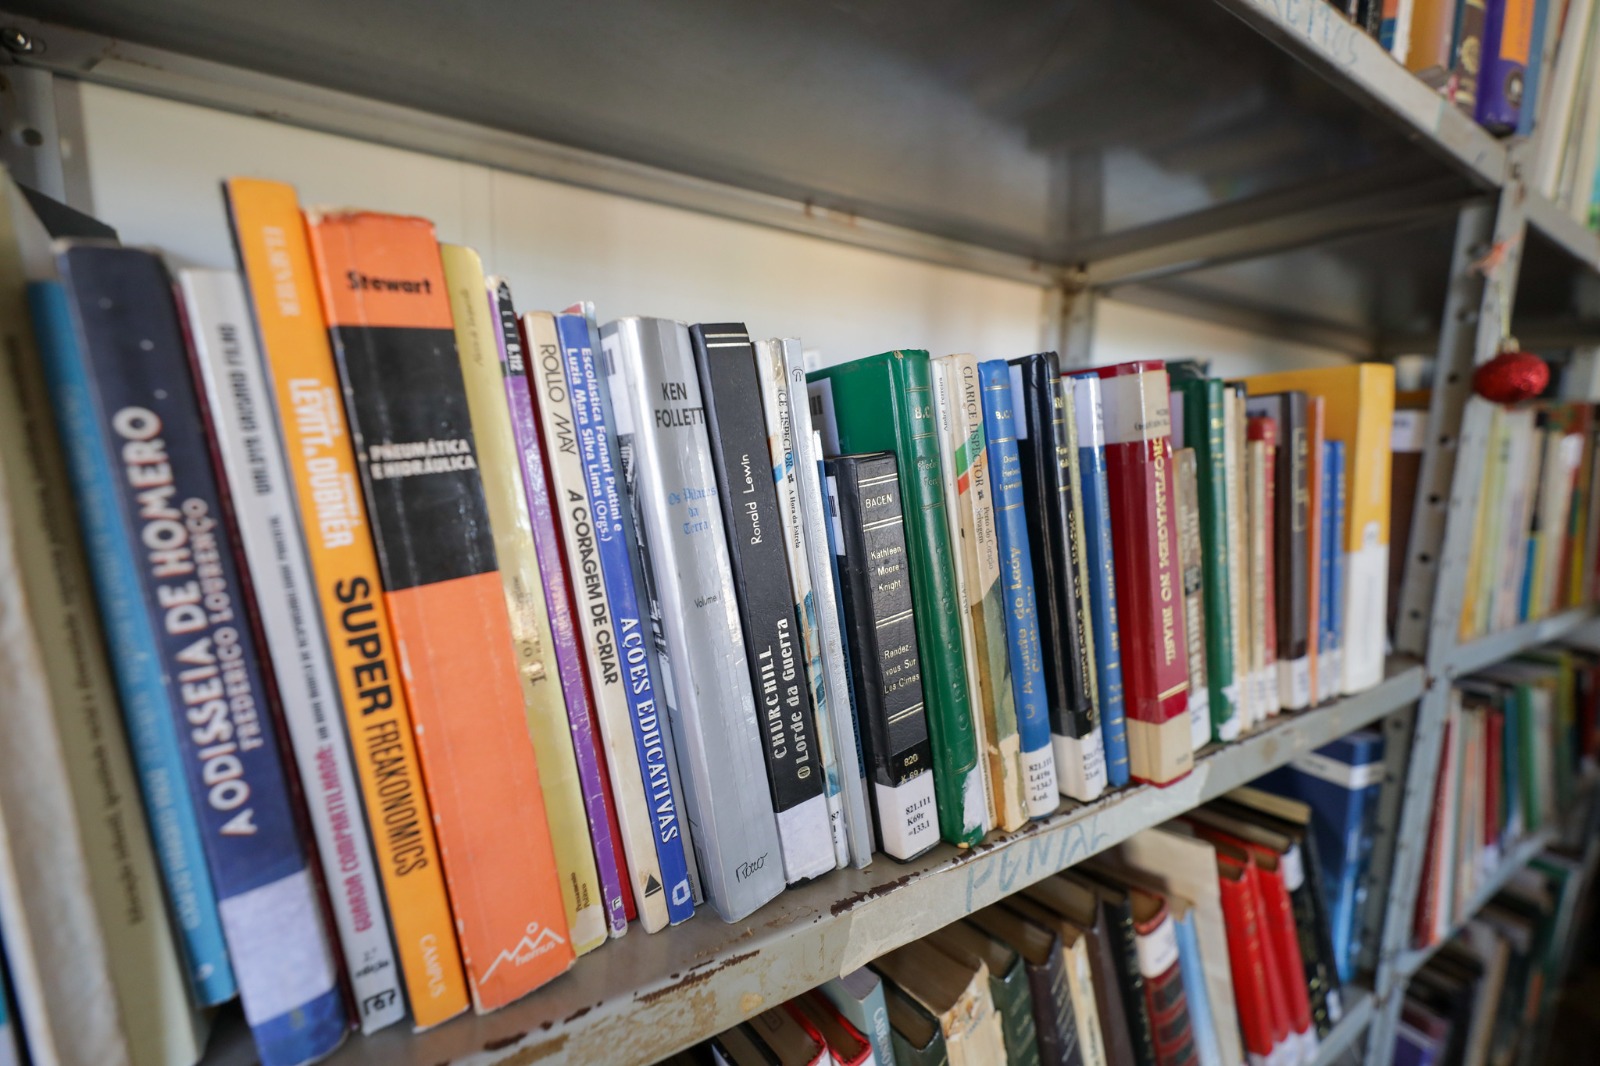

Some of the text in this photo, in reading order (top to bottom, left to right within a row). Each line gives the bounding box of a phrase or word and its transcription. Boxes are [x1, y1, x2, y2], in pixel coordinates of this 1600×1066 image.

[346, 270, 432, 294] Stewart
[567, 347, 581, 385] Luzia
[540, 343, 576, 455] ROLLO MAY
[574, 388, 588, 426] Mara
[661, 382, 688, 401] KEN
[581, 347, 603, 422] Escolástica
[604, 477, 620, 524] Puttini
[614, 523, 622, 532] e
[654, 406, 704, 429] FOLLETT
[962, 365, 985, 487] CLARICE LISPECTOR
[582, 428, 594, 462] Silva
[112, 406, 195, 578] HOMERO
[587, 462, 601, 498] Lima
[740, 453, 763, 545] Ronald Lewin
[865, 494, 893, 509] BACEN
[568, 488, 619, 686] A CORAGEM DE CRIAR
[877, 564, 900, 577] Moore
[878, 579, 902, 594] Knight
[1160, 572, 1172, 601] NO
[158, 581, 208, 635] DE
[182, 498, 264, 751] FREDERICO LOURENÇO
[693, 593, 719, 610] Volume
[1162, 605, 1174, 665] BRASIL
[759, 645, 787, 760] CHURCHILL
[776, 618, 811, 779] O Lorde da Guerra
[177, 637, 250, 811] ODISSEIA
[334, 576, 429, 878] SUPER FREAKONOMICS
[620, 617, 679, 843] AÇÕES EDUCATIVAS
[903, 753, 918, 767] 820
[219, 808, 258, 835] A
[905, 796, 931, 815] 821.111
[419, 932, 447, 998] CAMPUS
